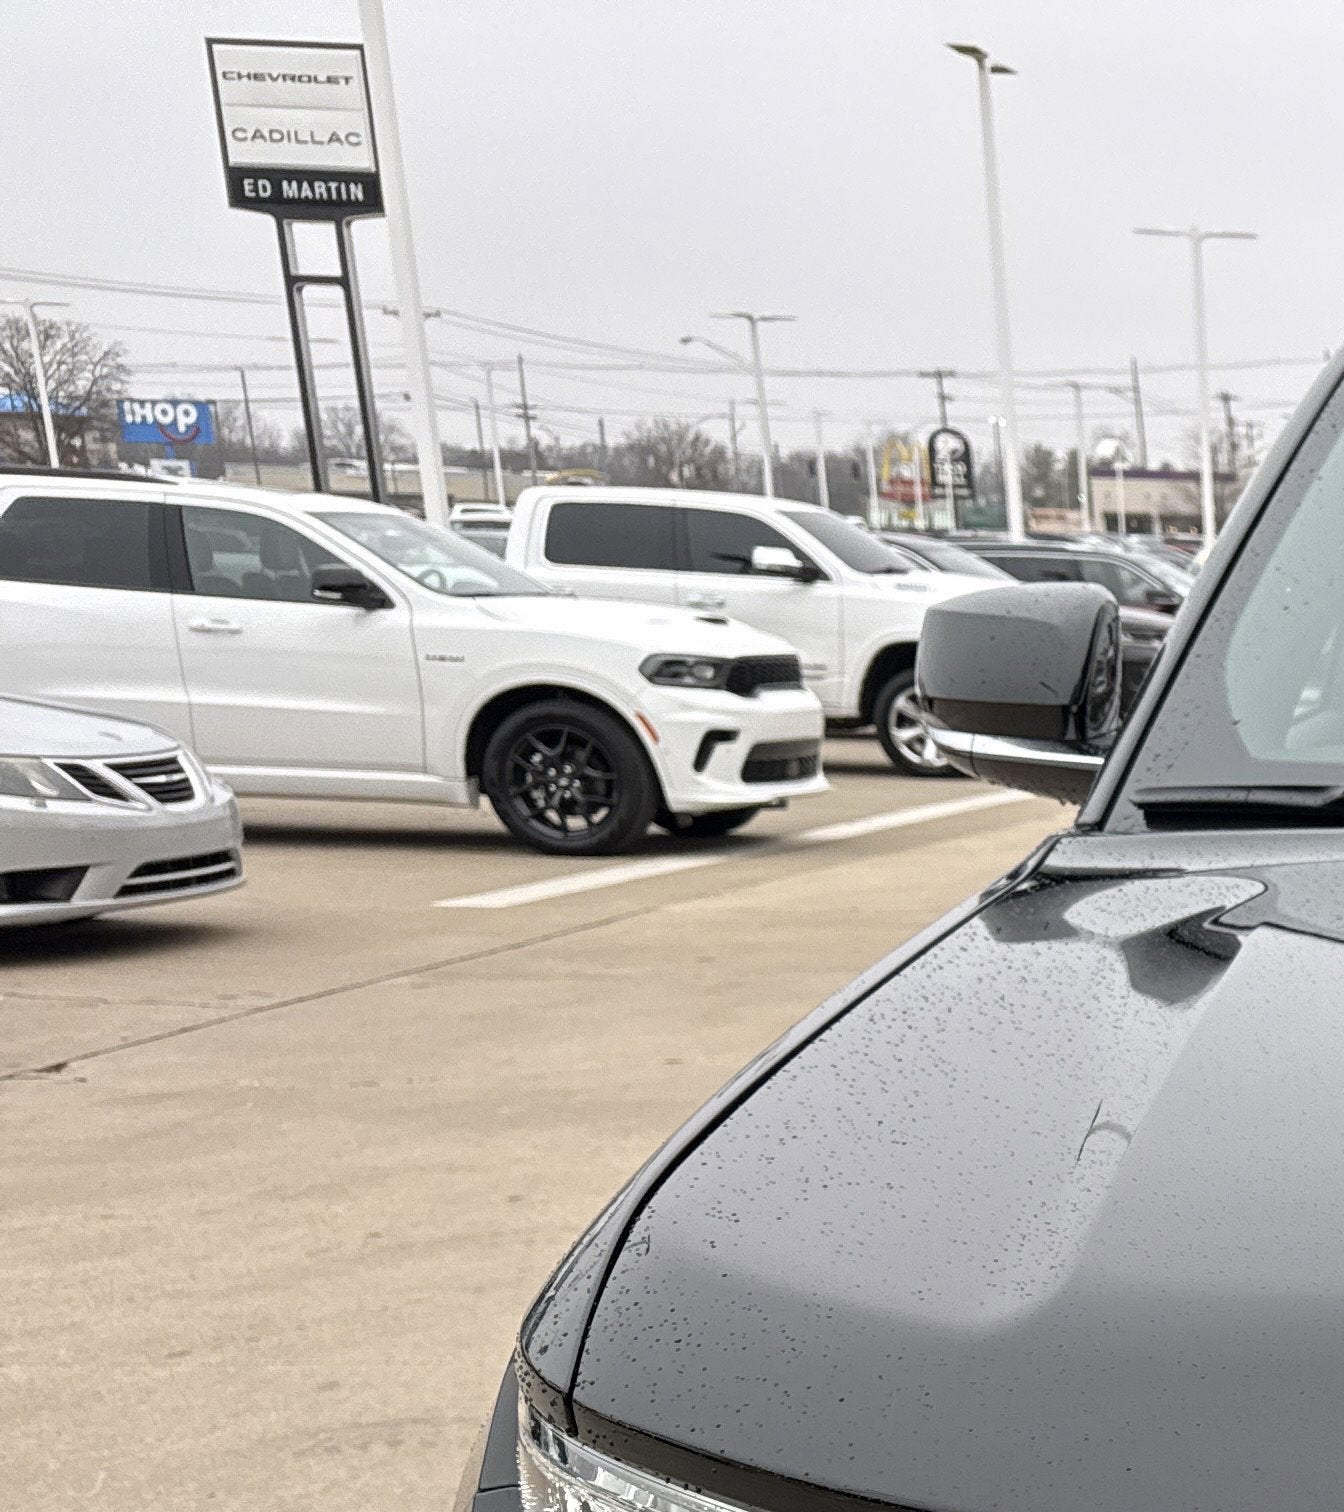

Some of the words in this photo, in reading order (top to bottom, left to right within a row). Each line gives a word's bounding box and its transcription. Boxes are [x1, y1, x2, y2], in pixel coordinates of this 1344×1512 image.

[222, 71, 353, 86] CHEVROLET
[231, 127, 362, 147] CADILLAC
[242, 178, 272, 199] ED
[281, 179, 364, 202] MARTIN
